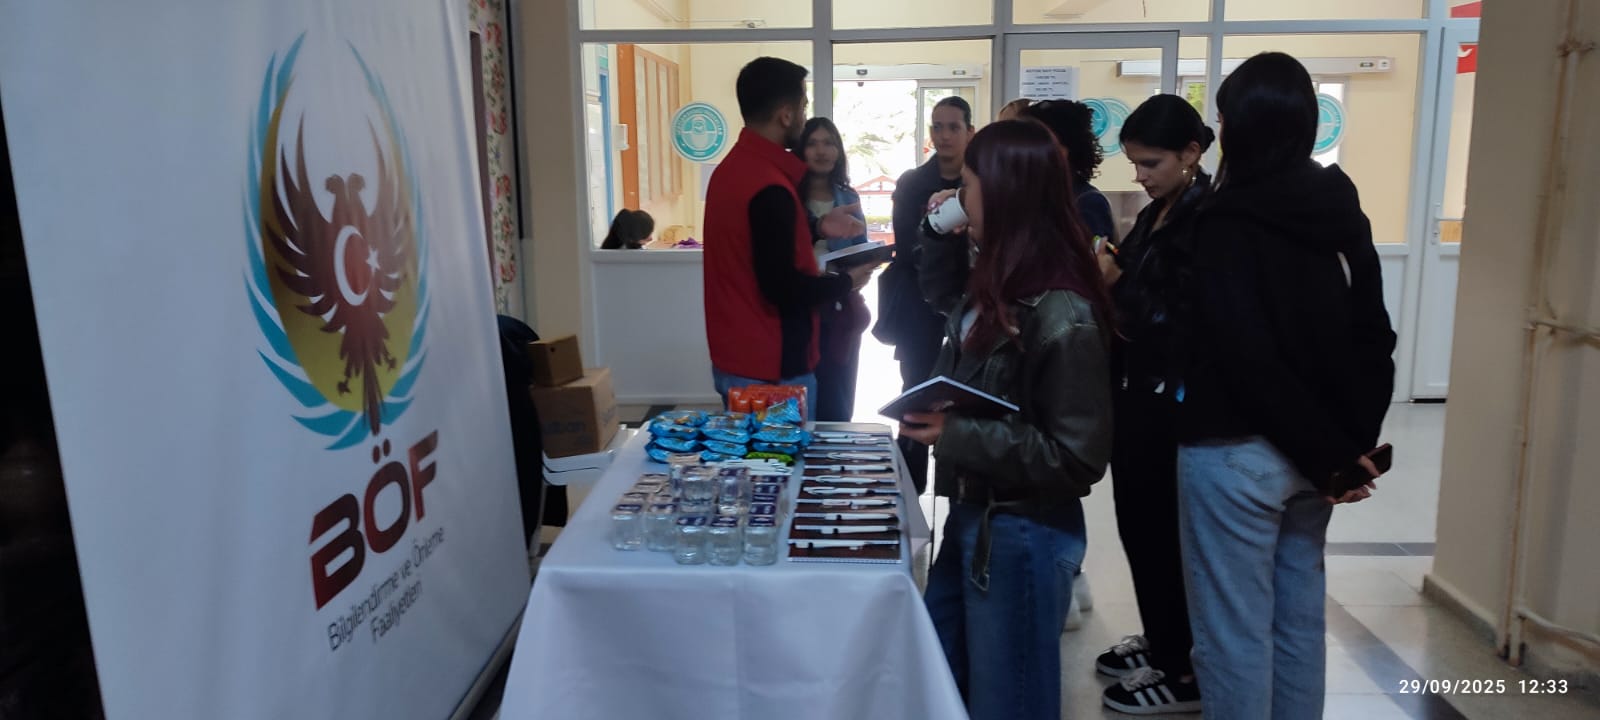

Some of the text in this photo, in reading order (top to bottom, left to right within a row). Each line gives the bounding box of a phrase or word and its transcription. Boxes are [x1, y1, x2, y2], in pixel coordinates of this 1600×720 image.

[309, 429, 438, 611] BÖF
[328, 526, 445, 652] Bilgilendirme ve Önleme
[370, 578, 423, 644] Faaliyetleri
